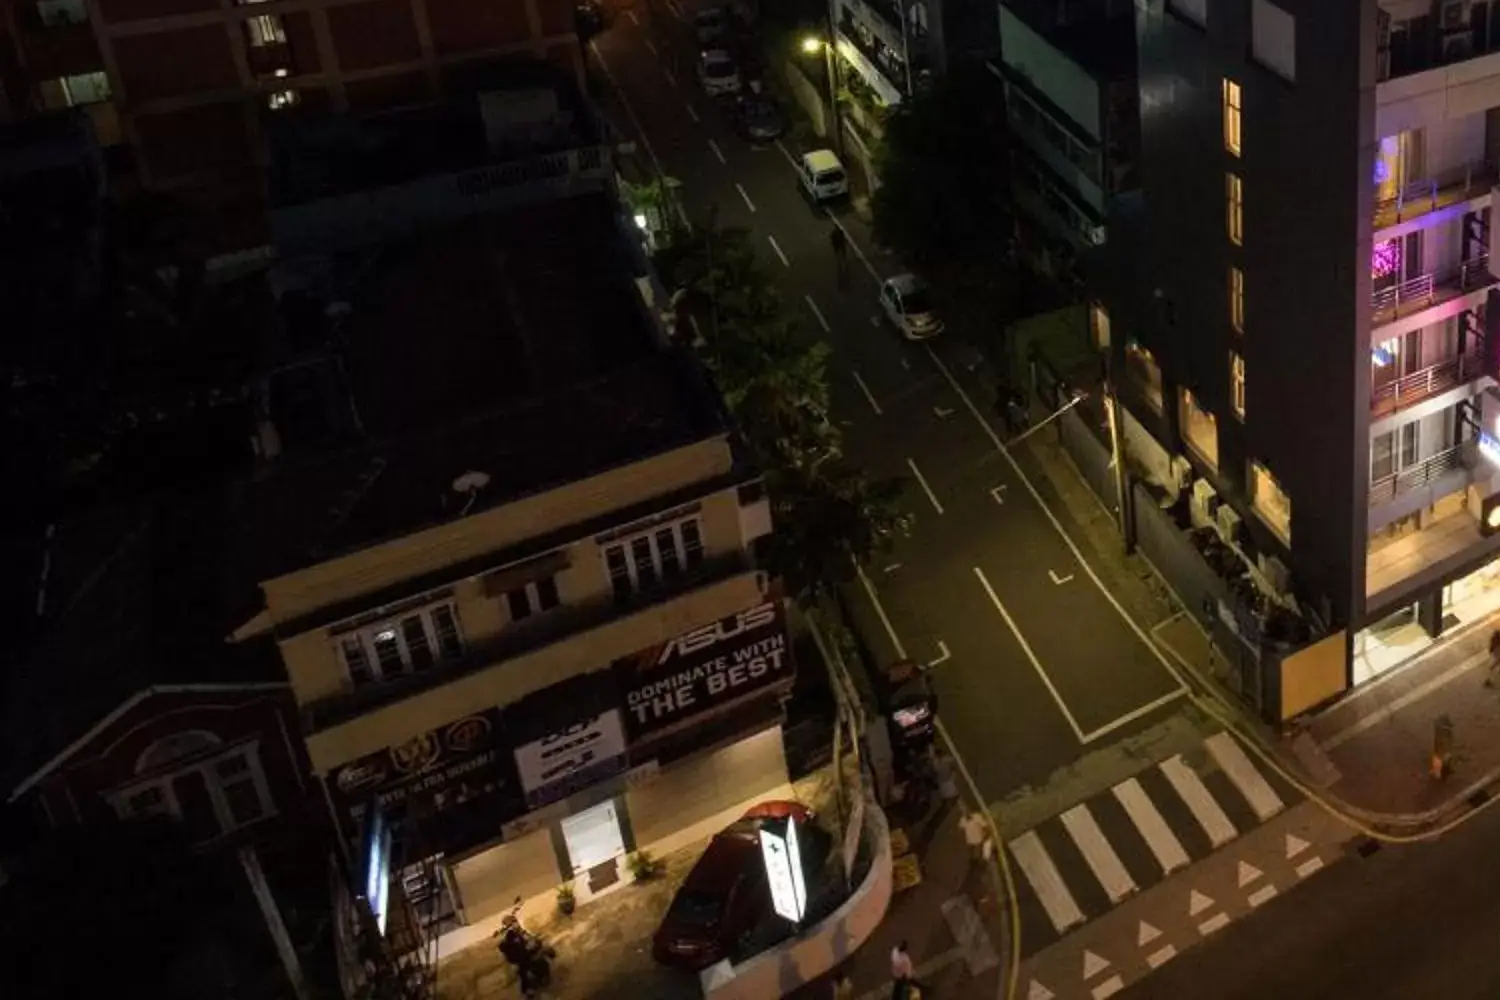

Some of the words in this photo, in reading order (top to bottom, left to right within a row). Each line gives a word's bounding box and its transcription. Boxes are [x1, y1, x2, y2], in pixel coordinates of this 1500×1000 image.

[627, 655, 729, 706] DOMINATE
[733, 633, 784, 663] WITH
[657, 600, 777, 667] ASUS
[630, 683, 697, 725] THE
[706, 647, 785, 696] BEST
